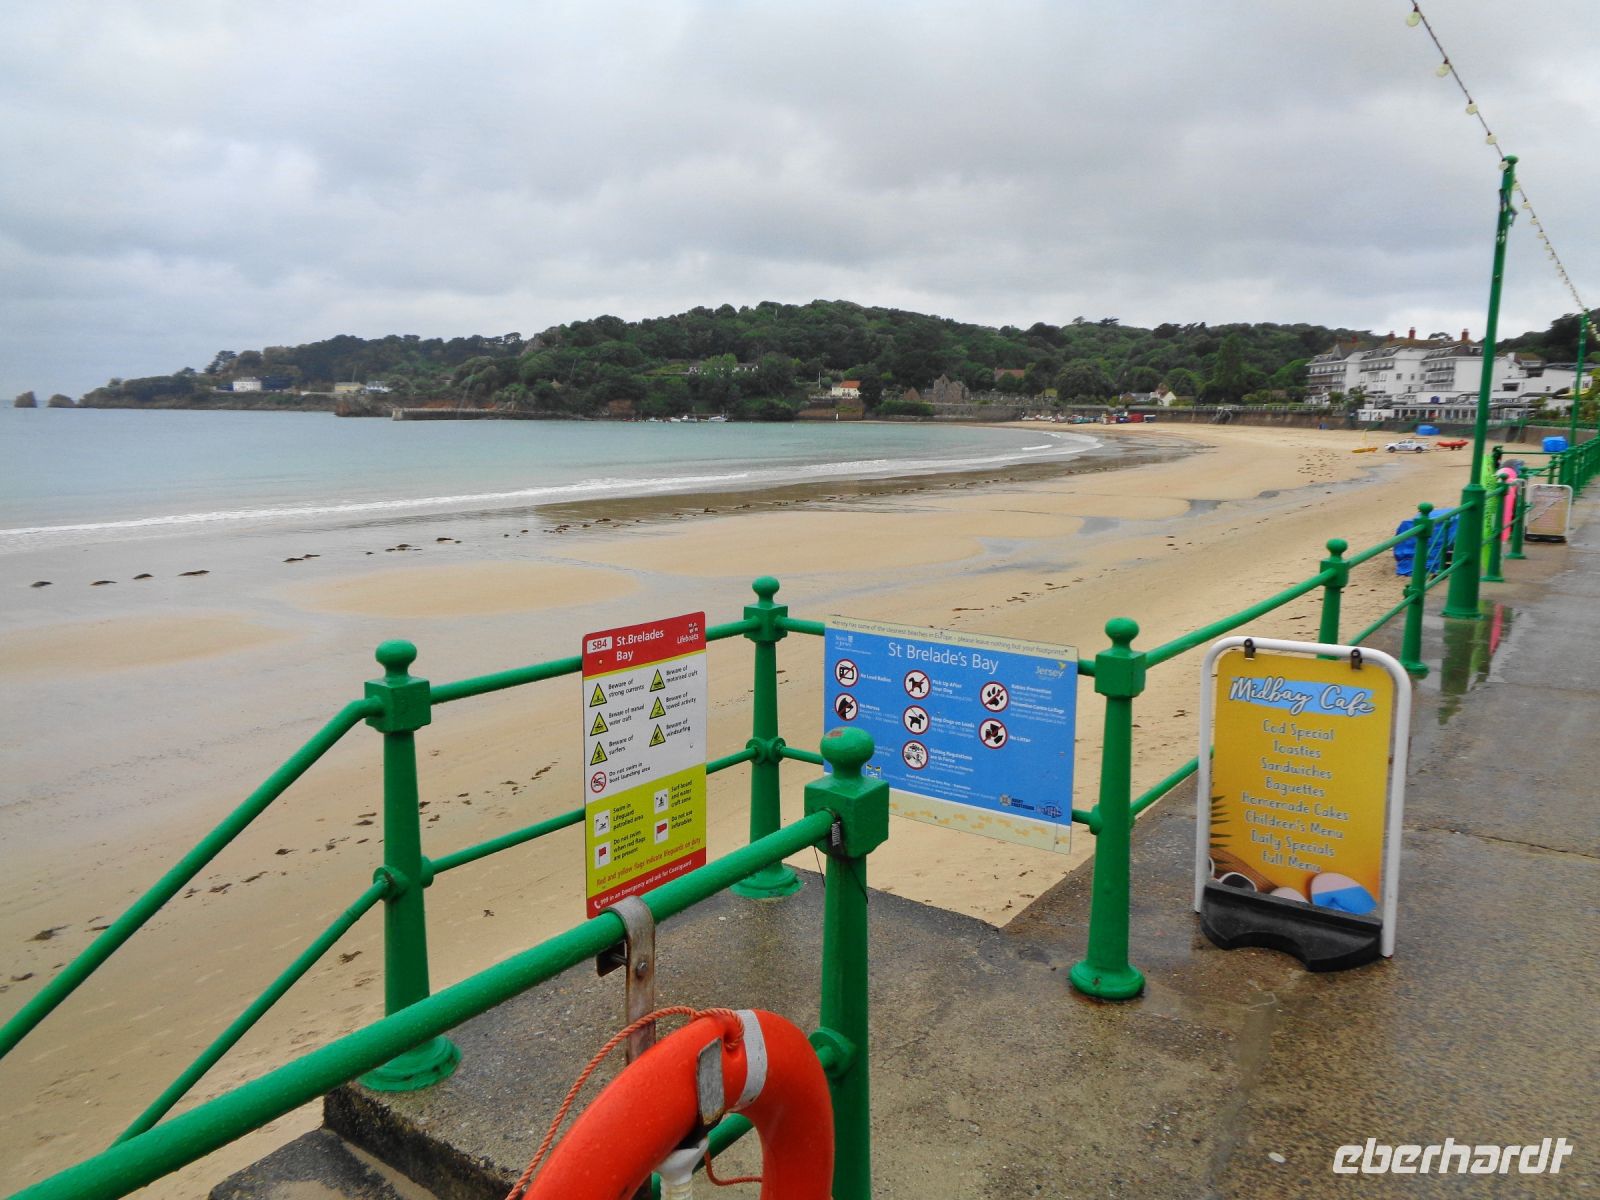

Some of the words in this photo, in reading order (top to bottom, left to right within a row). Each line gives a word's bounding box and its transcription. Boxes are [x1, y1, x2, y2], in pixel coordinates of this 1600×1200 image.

[592, 639, 607, 651] SB4
[616, 650, 634, 662] Bay
[888, 642, 902, 658] St
[907, 644, 967, 666] Brelade's
[972, 653, 999, 675] Bay
[666, 668, 682, 676] Beware
[608, 681, 627, 690] Beware
[628, 678, 634, 686] of
[608, 689, 625, 698] strong
[626, 684, 645, 693] currents
[666, 695, 682, 703] Beware
[1229, 676, 1313, 716] Midbay
[608, 710, 625, 719] Beware
[625, 708, 630, 716] of
[666, 722, 682, 730] Beware
[682, 718, 688, 726] of
[1290, 723, 1334, 741] Special
[608, 738, 627, 747] Beware
[628, 735, 634, 743] of
[608, 746, 626, 755] surfers
[1273, 740, 1321, 759] Toasties
[620, 770, 641, 780] launching
[625, 764, 638, 772] swim
[1261, 757, 1333, 779] Sandwiches
[1265, 777, 1325, 797] Baguettes
[613, 805, 626, 813] Swim
[1242, 792, 1310, 814] Homemade
[1313, 803, 1349, 821] Cakes
[613, 817, 634, 831] patrolled
[1245, 810, 1305, 832] Children's
[1310, 823, 1344, 839] Menu
[620, 834, 629, 842] not
[629, 830, 642, 839] swim
[613, 844, 627, 853] when
[627, 840, 635, 848] red
[635, 837, 646, 845] flags
[1251, 830, 1281, 848] Daily
[1286, 836, 1335, 857] Specials
[621, 846, 639, 859] present
[1262, 851, 1283, 865] Full
[1288, 857, 1321, 873] Menu
[607, 872, 617, 881] and
[633, 861, 645, 871] flags
[621, 881, 645, 896] Emergency
[646, 877, 654, 885] and
[661, 870, 669, 878] for
[668, 860, 692, 874] Coastguard
